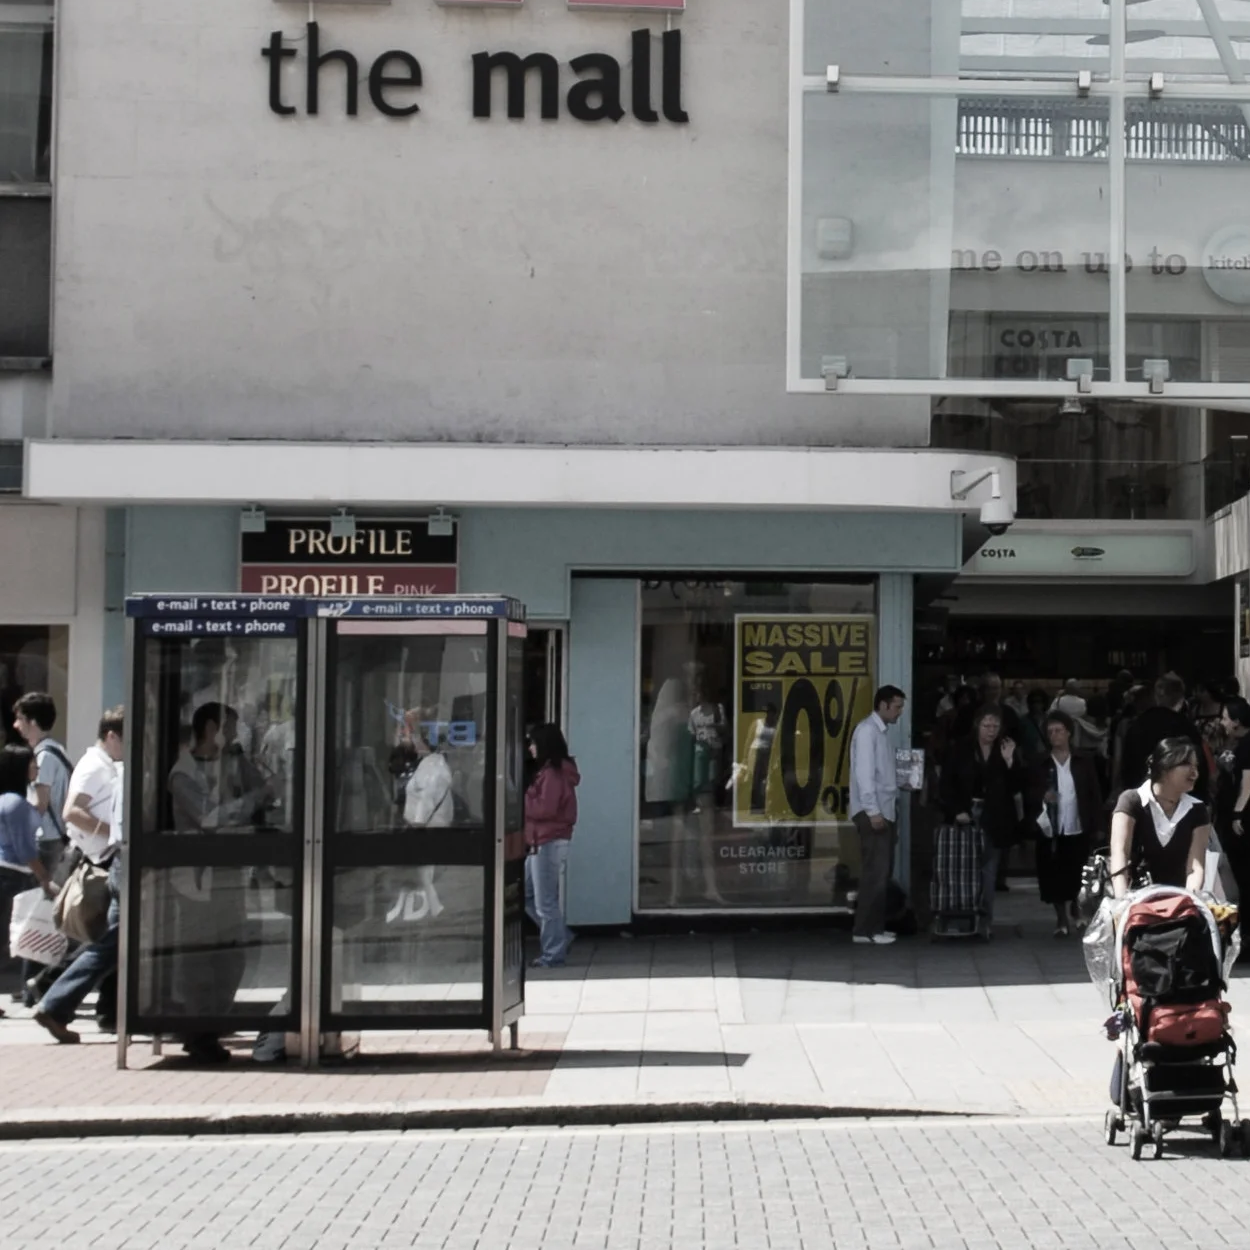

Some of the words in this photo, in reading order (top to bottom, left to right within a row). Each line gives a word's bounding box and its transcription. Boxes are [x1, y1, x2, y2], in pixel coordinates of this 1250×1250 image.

[261, 21, 423, 118] the
[471, 28, 689, 124] mall
[1015, 249, 1067, 274] on
[1147, 246, 1188, 276] to
[1000, 328, 1082, 350] COSTA
[288, 529, 412, 554] PROFILE
[981, 549, 1016, 558] COSTA
[261, 575, 384, 595] PROFILE
[394, 584, 436, 595] PINK
[157, 599, 197, 611] e-mail
[211, 600, 237, 611] text
[250, 599, 290, 614] phone
[362, 603, 402, 614] e-mail
[415, 604, 441, 615] text
[453, 603, 494, 618] phone
[152, 620, 193, 633] e-mail
[206, 621, 232, 633] text
[245, 620, 285, 636] phone
[744, 625, 866, 647] MASSIVE
[744, 652, 867, 674] SALE
[720, 846, 805, 858] CLEARANCE
[739, 862, 787, 875] STORE
